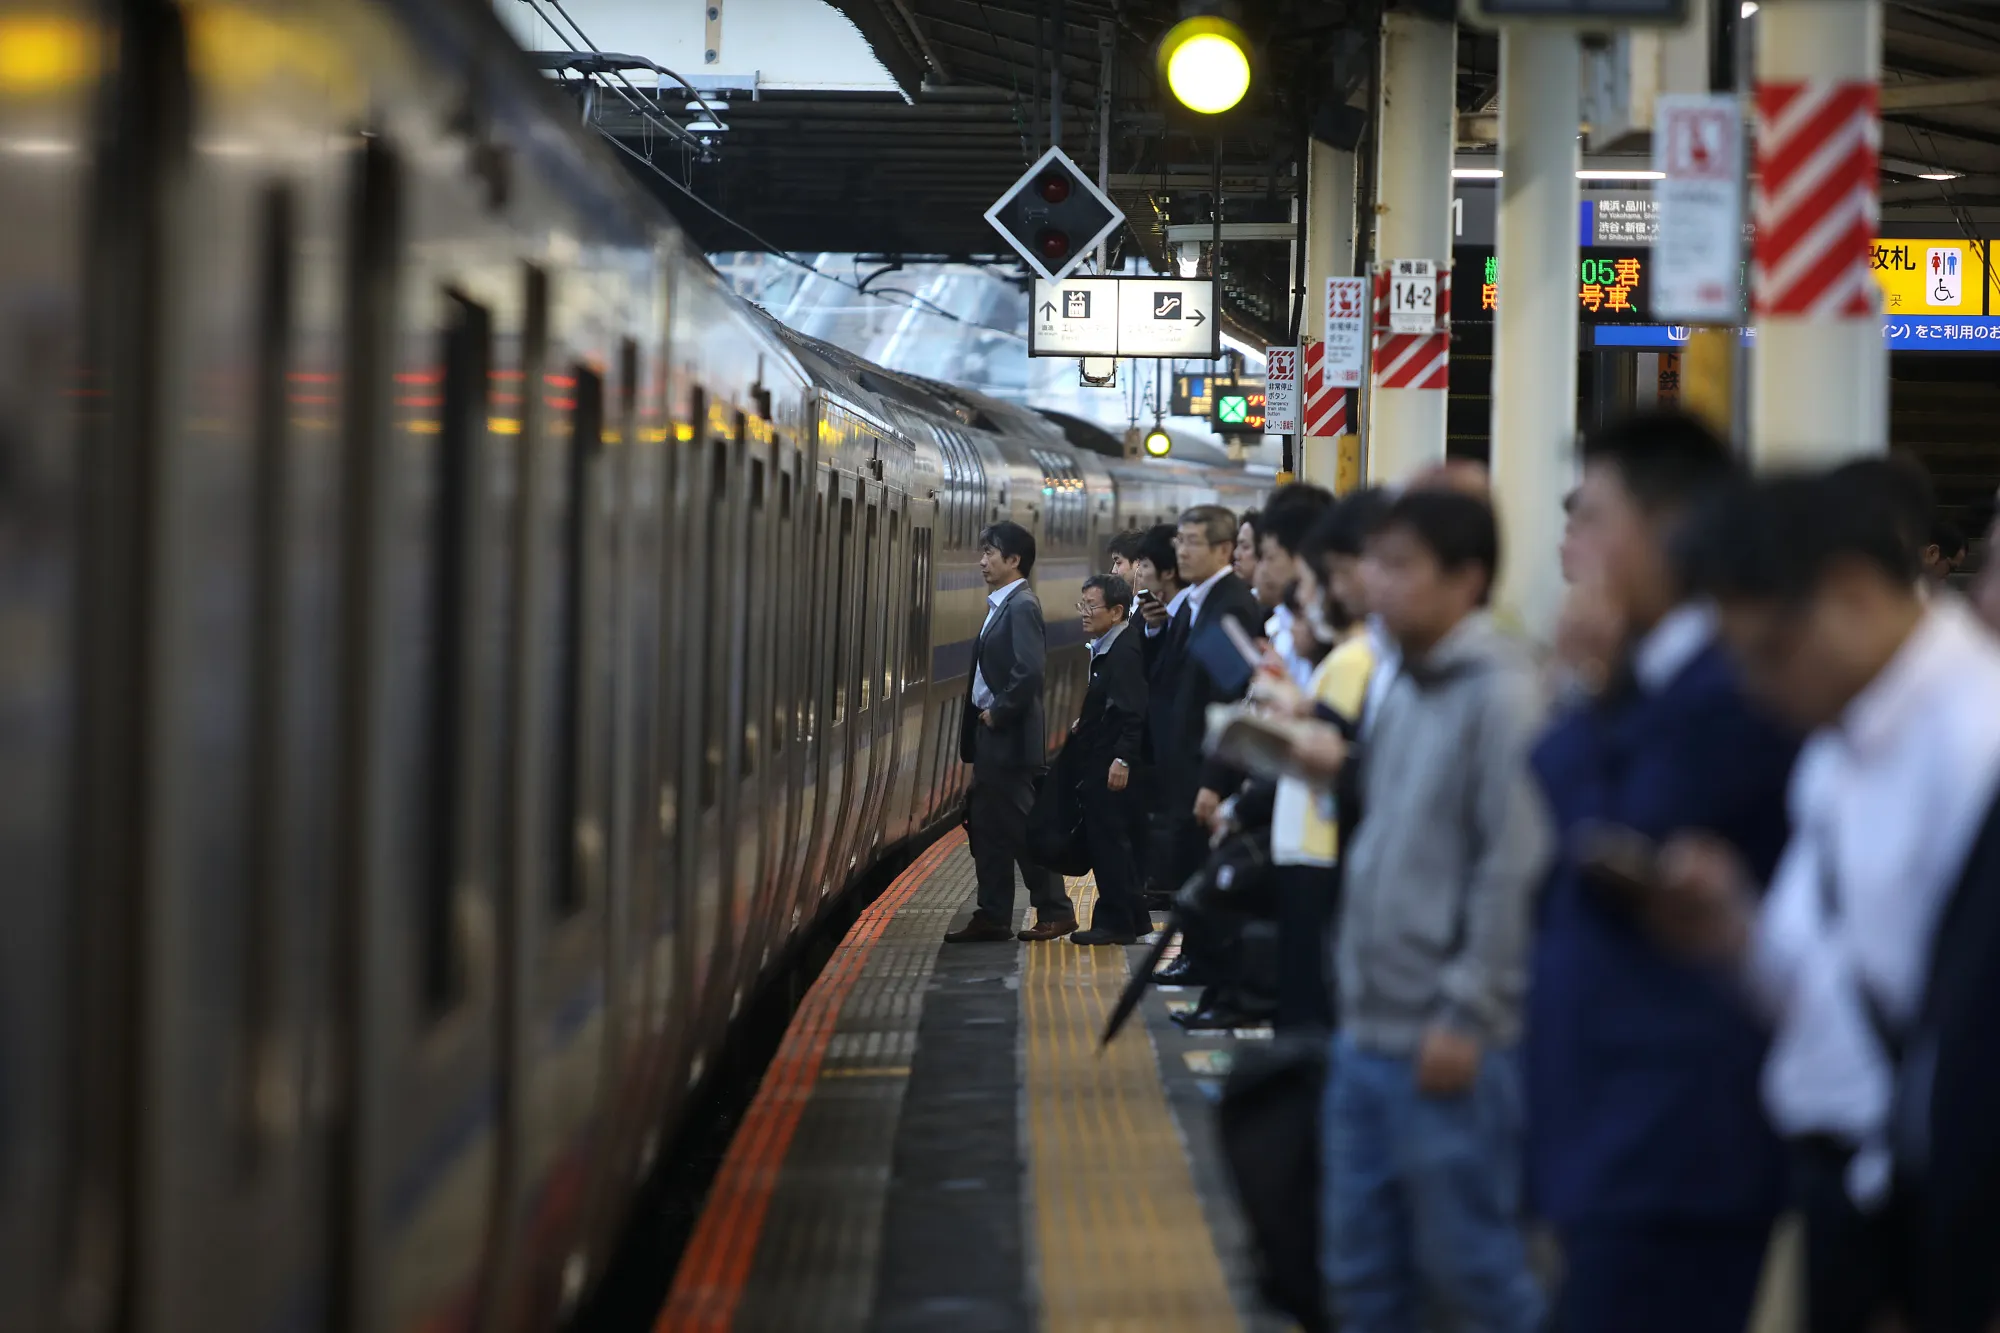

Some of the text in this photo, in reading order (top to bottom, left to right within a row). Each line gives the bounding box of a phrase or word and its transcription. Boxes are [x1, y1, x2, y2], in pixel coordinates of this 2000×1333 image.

[1396, 282, 1432, 310] 14-2
[1268, 383, 1293, 391] 非常停止
[1268, 392, 1287, 400] ボタン
